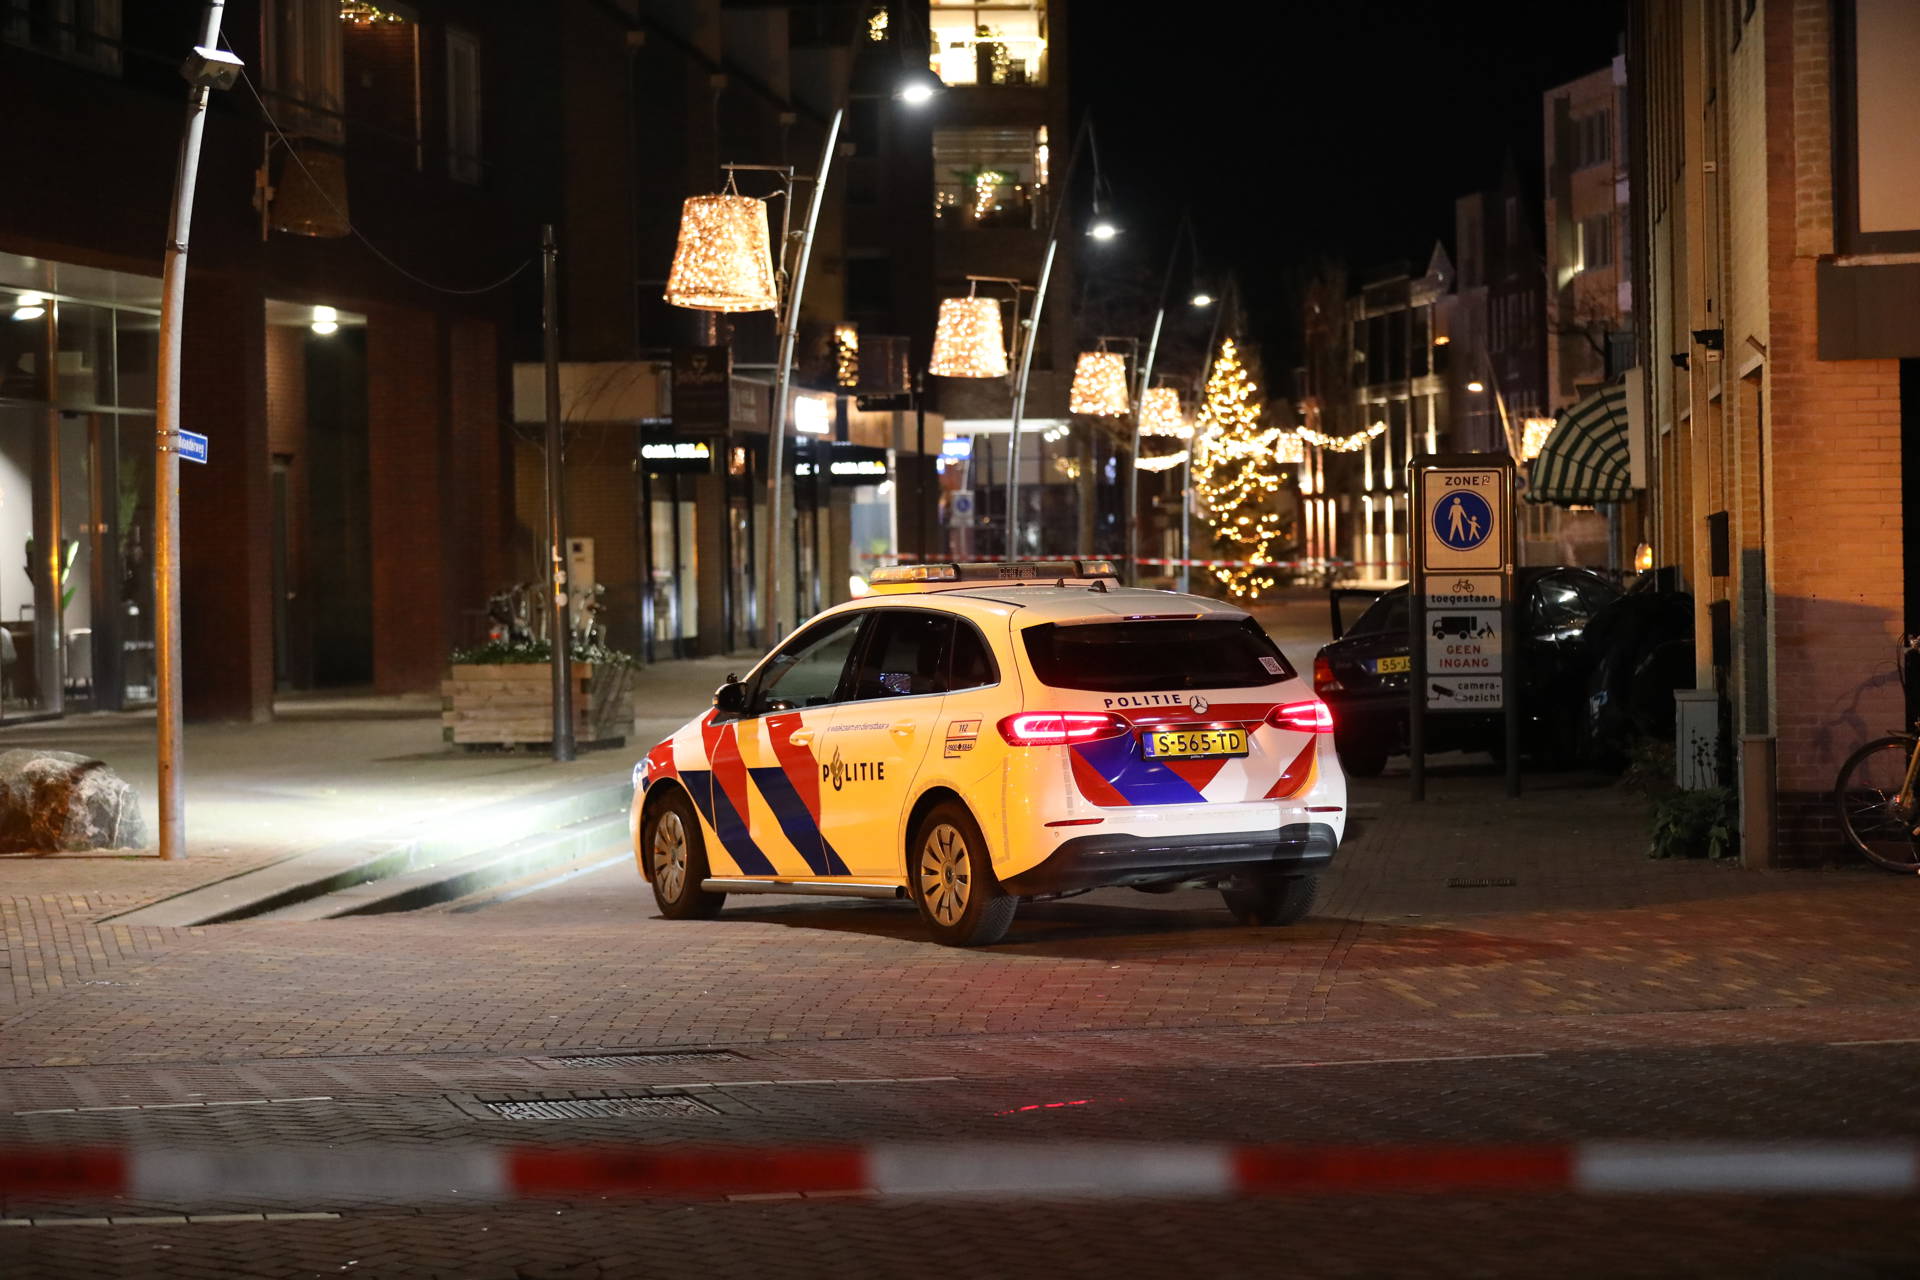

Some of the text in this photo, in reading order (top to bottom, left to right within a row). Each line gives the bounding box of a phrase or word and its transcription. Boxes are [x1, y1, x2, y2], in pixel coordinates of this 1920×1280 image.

[1445, 476, 1480, 486] ZONE
[1431, 594, 1496, 606] toegestaan
[1446, 645, 1481, 655] GEEN
[1440, 659, 1489, 668] INGANG
[1457, 680, 1500, 690] camera-
[1104, 694, 1182, 709] POLITIE
[1159, 733, 1240, 753] S-565-TD
[822, 762, 885, 792] POLITIE
